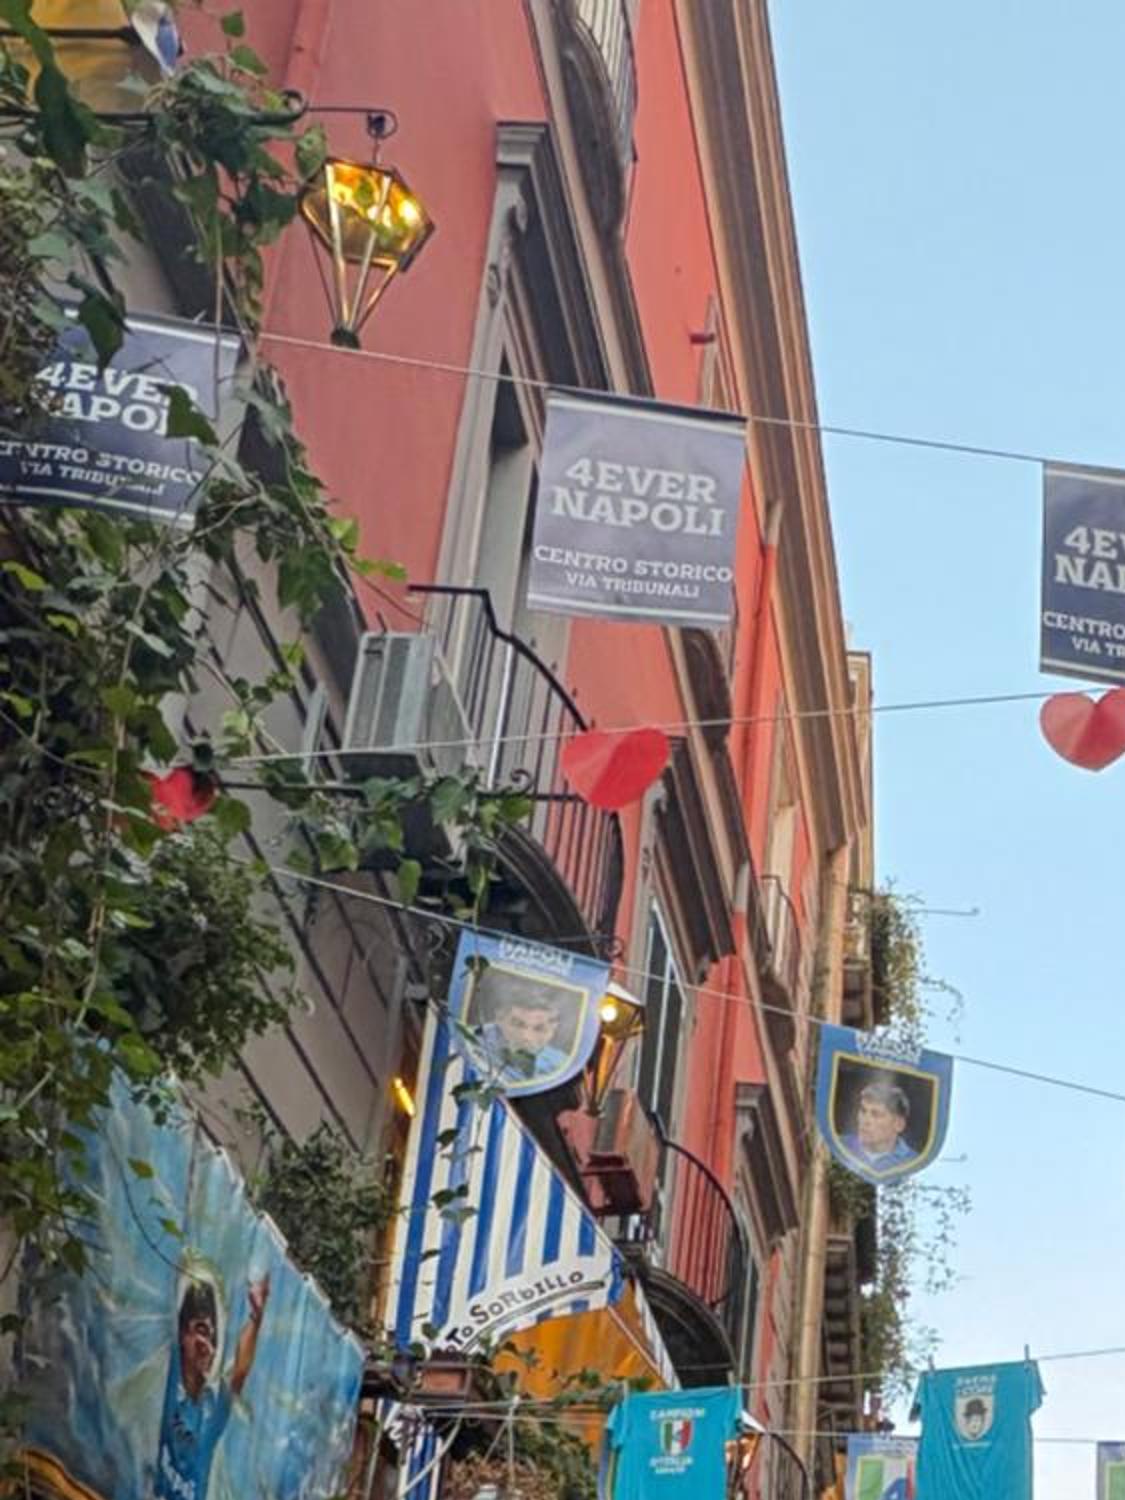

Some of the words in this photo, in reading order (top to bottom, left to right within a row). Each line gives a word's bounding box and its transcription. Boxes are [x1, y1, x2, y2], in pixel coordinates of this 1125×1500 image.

[566, 458, 716, 503] 4EVER
[551, 485, 725, 536] NAPOLI
[533, 545, 628, 574] CENTRO
[634, 560, 733, 583] STORICO
[565, 572, 597, 588] VIA
[603, 576, 700, 598] TRIBUNALI
[1072, 637, 1101, 655] VIA
